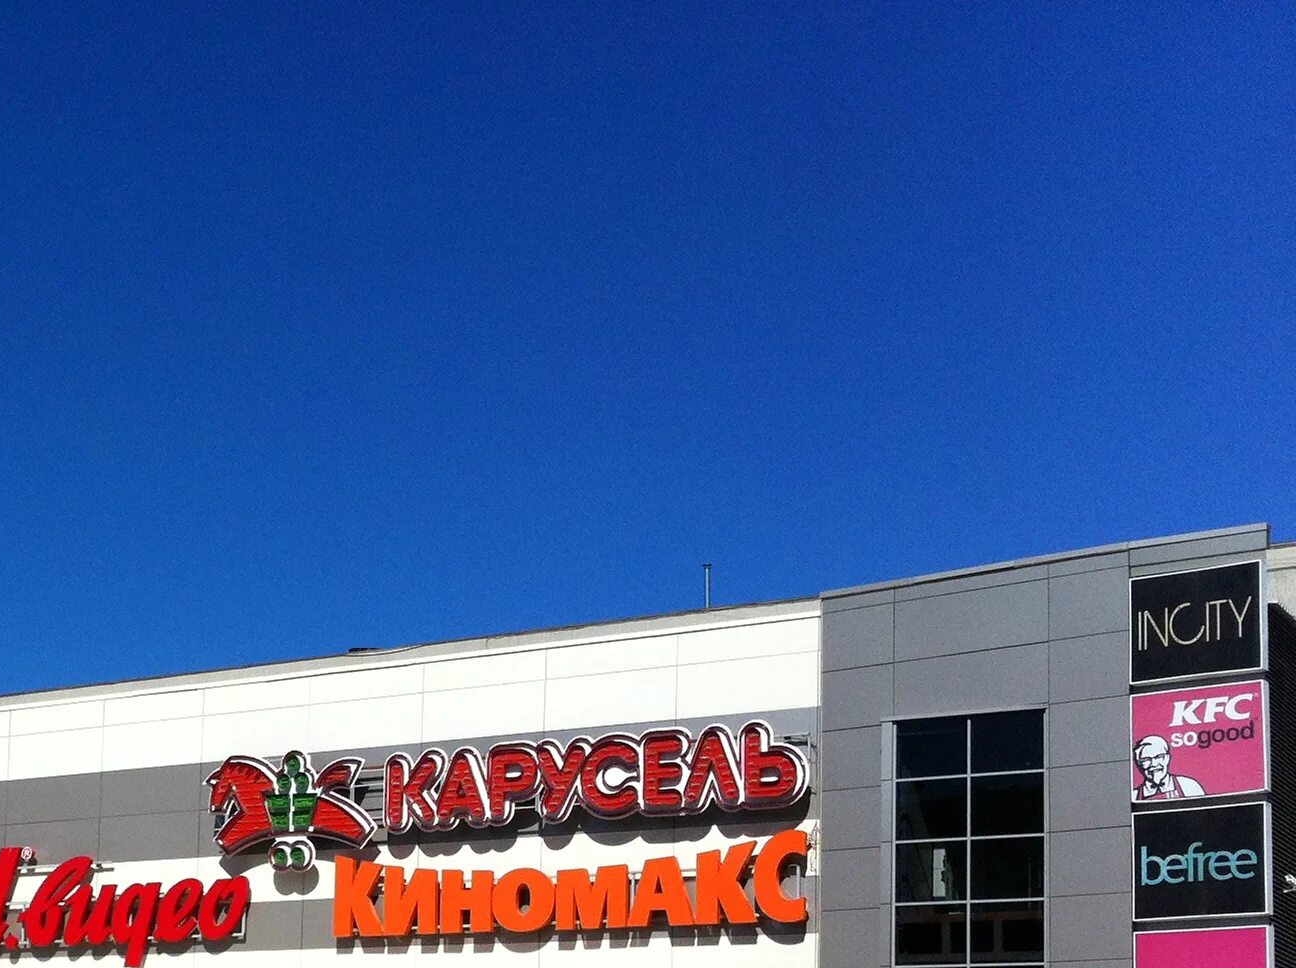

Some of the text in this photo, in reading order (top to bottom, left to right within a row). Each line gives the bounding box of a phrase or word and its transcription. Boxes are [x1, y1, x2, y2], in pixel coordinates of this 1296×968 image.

[1138, 596, 1252, 650] INCITY
[1168, 693, 1253, 727] KFC
[384, 720, 809, 833] КАРУСЕЛЬ
[333, 830, 809, 938] КИНОМАКС
[1140, 842, 1258, 886] befree
